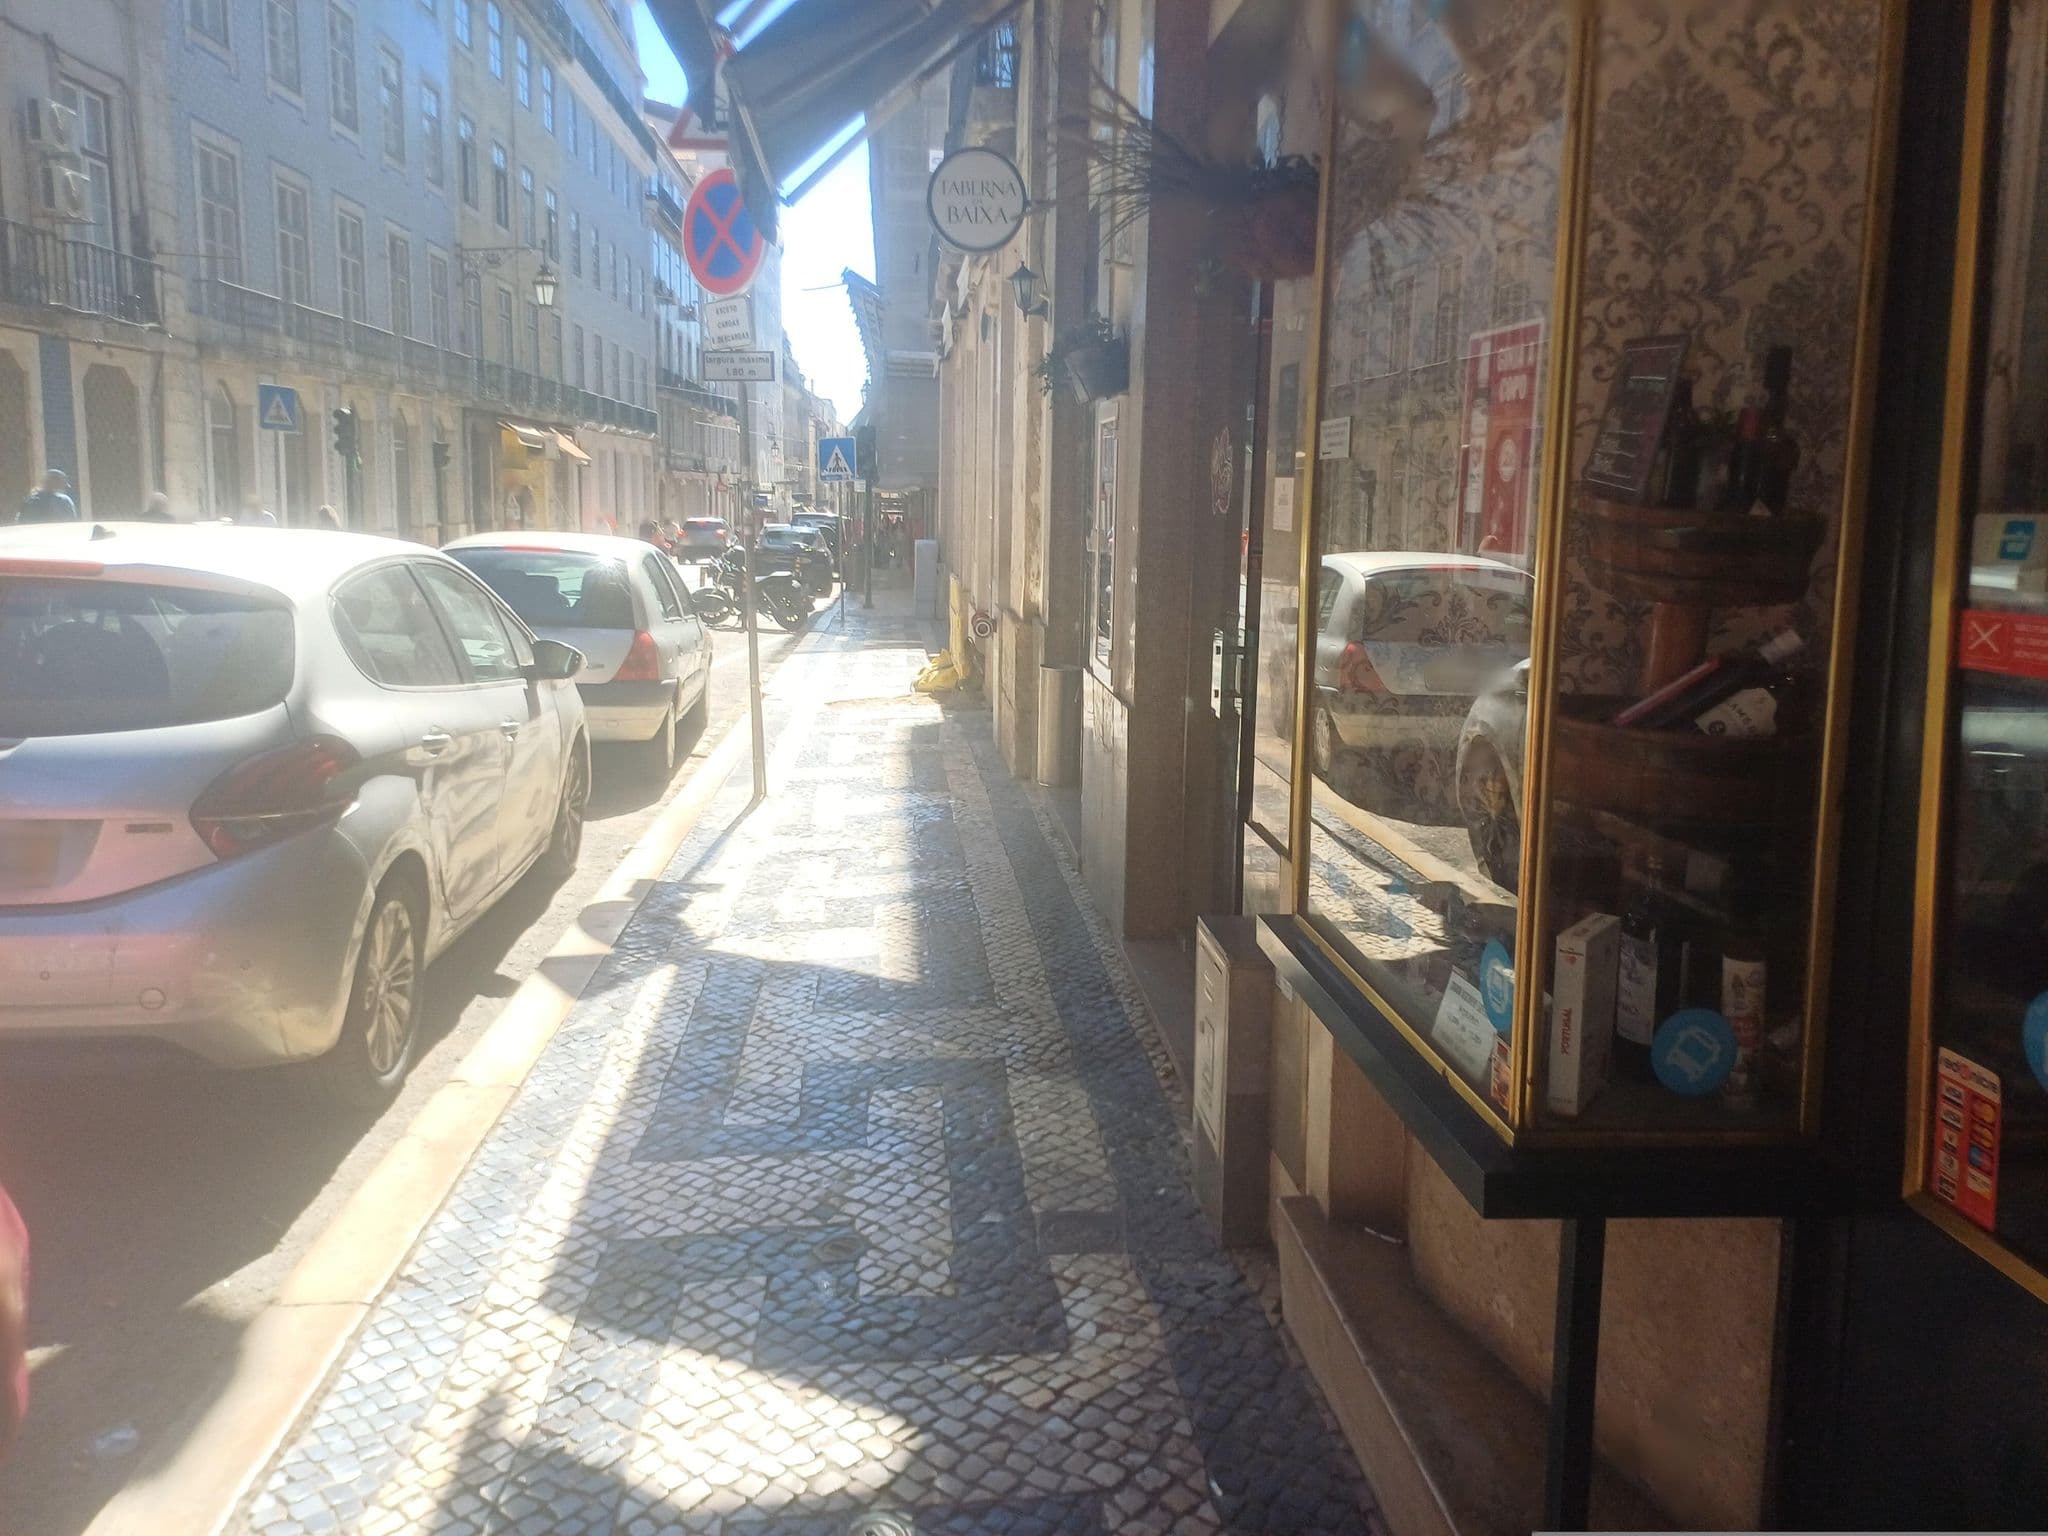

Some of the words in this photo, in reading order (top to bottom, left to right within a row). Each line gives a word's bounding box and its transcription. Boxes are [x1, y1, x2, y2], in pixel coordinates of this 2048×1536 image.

[941, 179, 1017, 198] TABERNA
[947, 205, 1009, 224] BAIXA
[1560, 1007, 1572, 1055] PORTUGAL
